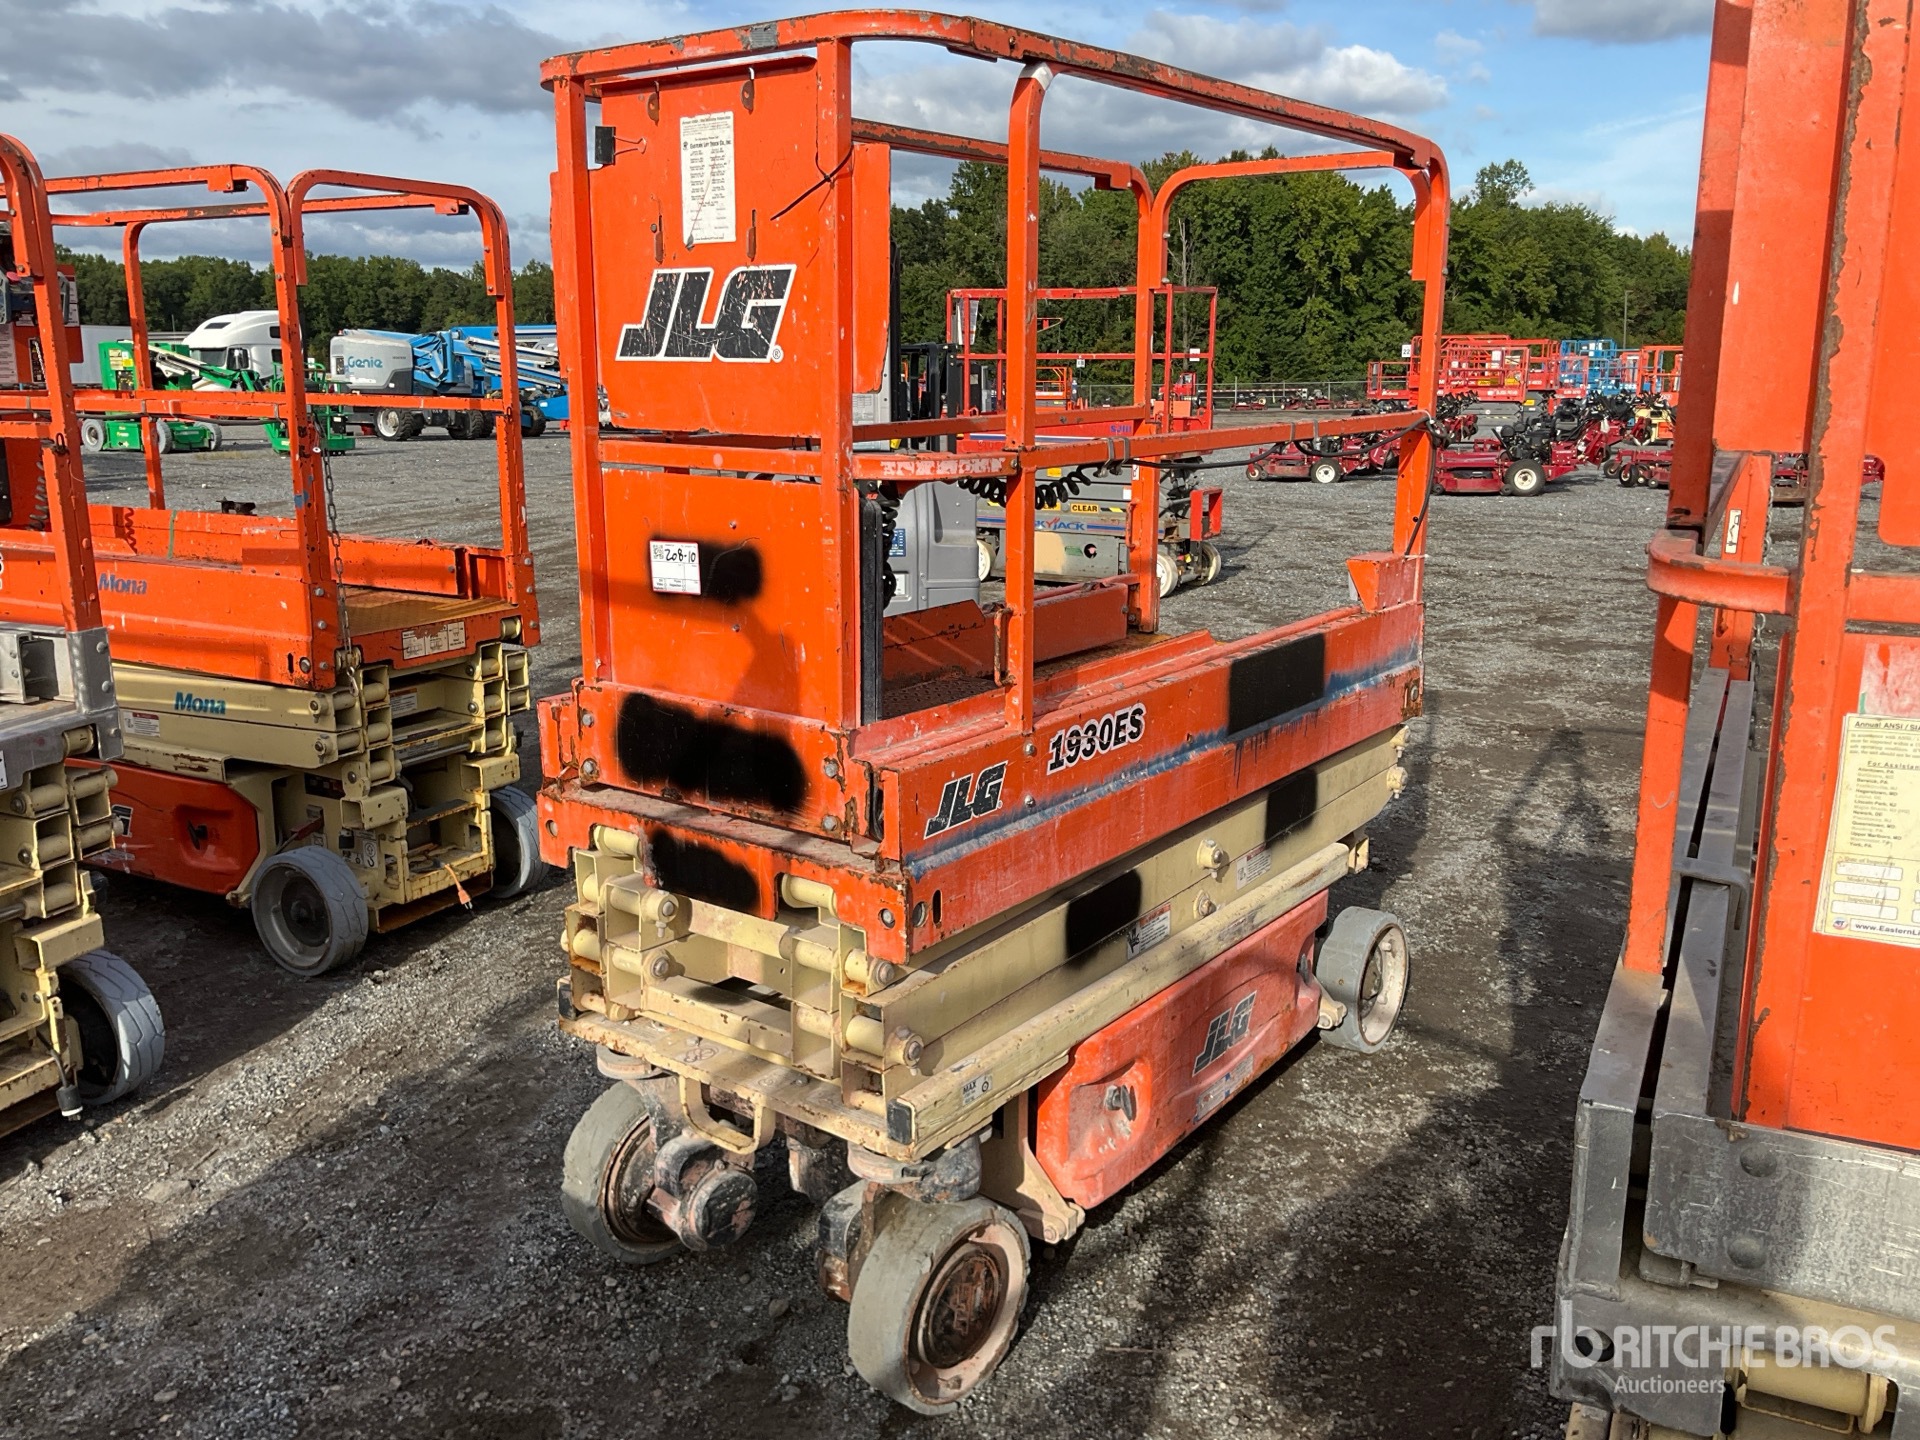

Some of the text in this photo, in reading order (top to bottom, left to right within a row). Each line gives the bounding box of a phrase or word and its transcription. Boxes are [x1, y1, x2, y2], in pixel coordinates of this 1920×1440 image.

[615, 264, 797, 363] JLG
[347, 356, 383, 368] Genie
[1071, 504, 1098, 512] CLEAR
[1035, 516, 1085, 531] KYJACK
[98, 572, 147, 595] Mona
[173, 691, 226, 715] Mona
[1855, 721, 1881, 729] Annual
[1047, 703, 1147, 775] 1930ES
[924, 760, 1008, 840] JLG
[1192, 990, 1257, 1077] JLG
[963, 1080, 976, 1094] MAX
